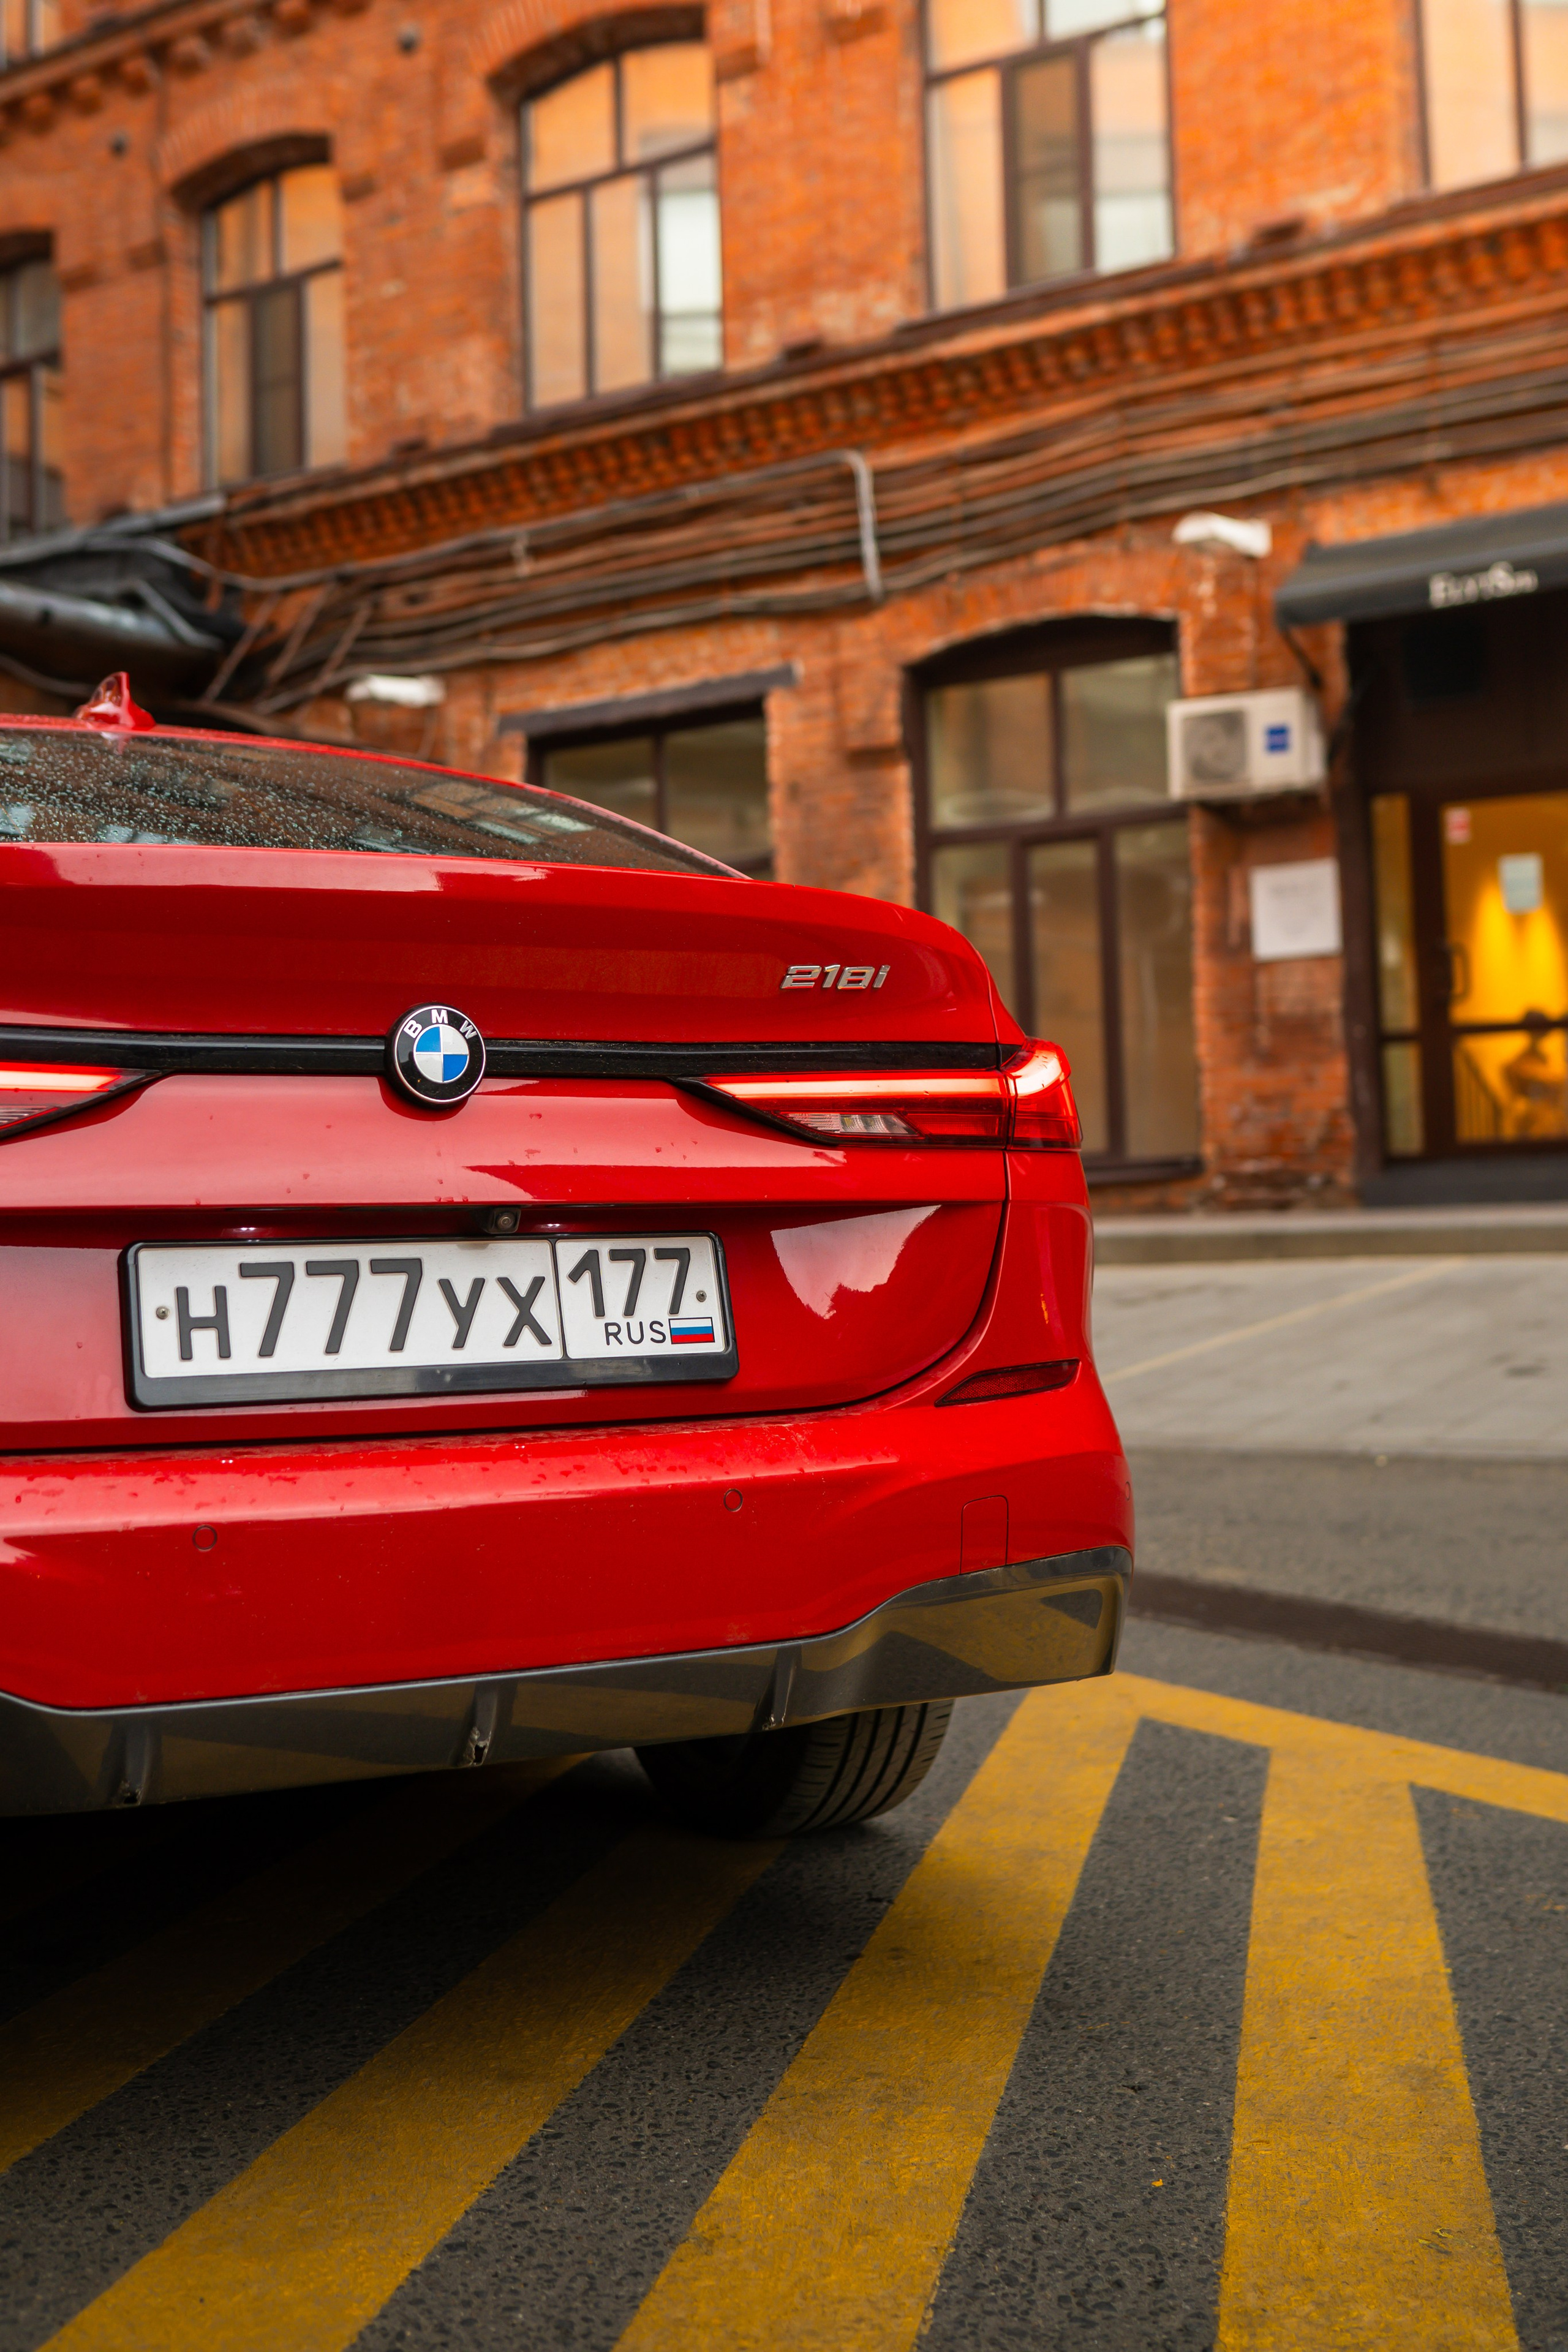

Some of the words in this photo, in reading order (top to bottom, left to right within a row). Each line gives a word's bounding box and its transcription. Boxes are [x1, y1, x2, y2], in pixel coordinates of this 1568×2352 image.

[780, 964, 891, 990] 218i
[403, 1009, 478, 1040] BMW
[567, 1247, 692, 1317] 177
[604, 1320, 667, 1346] RUS
